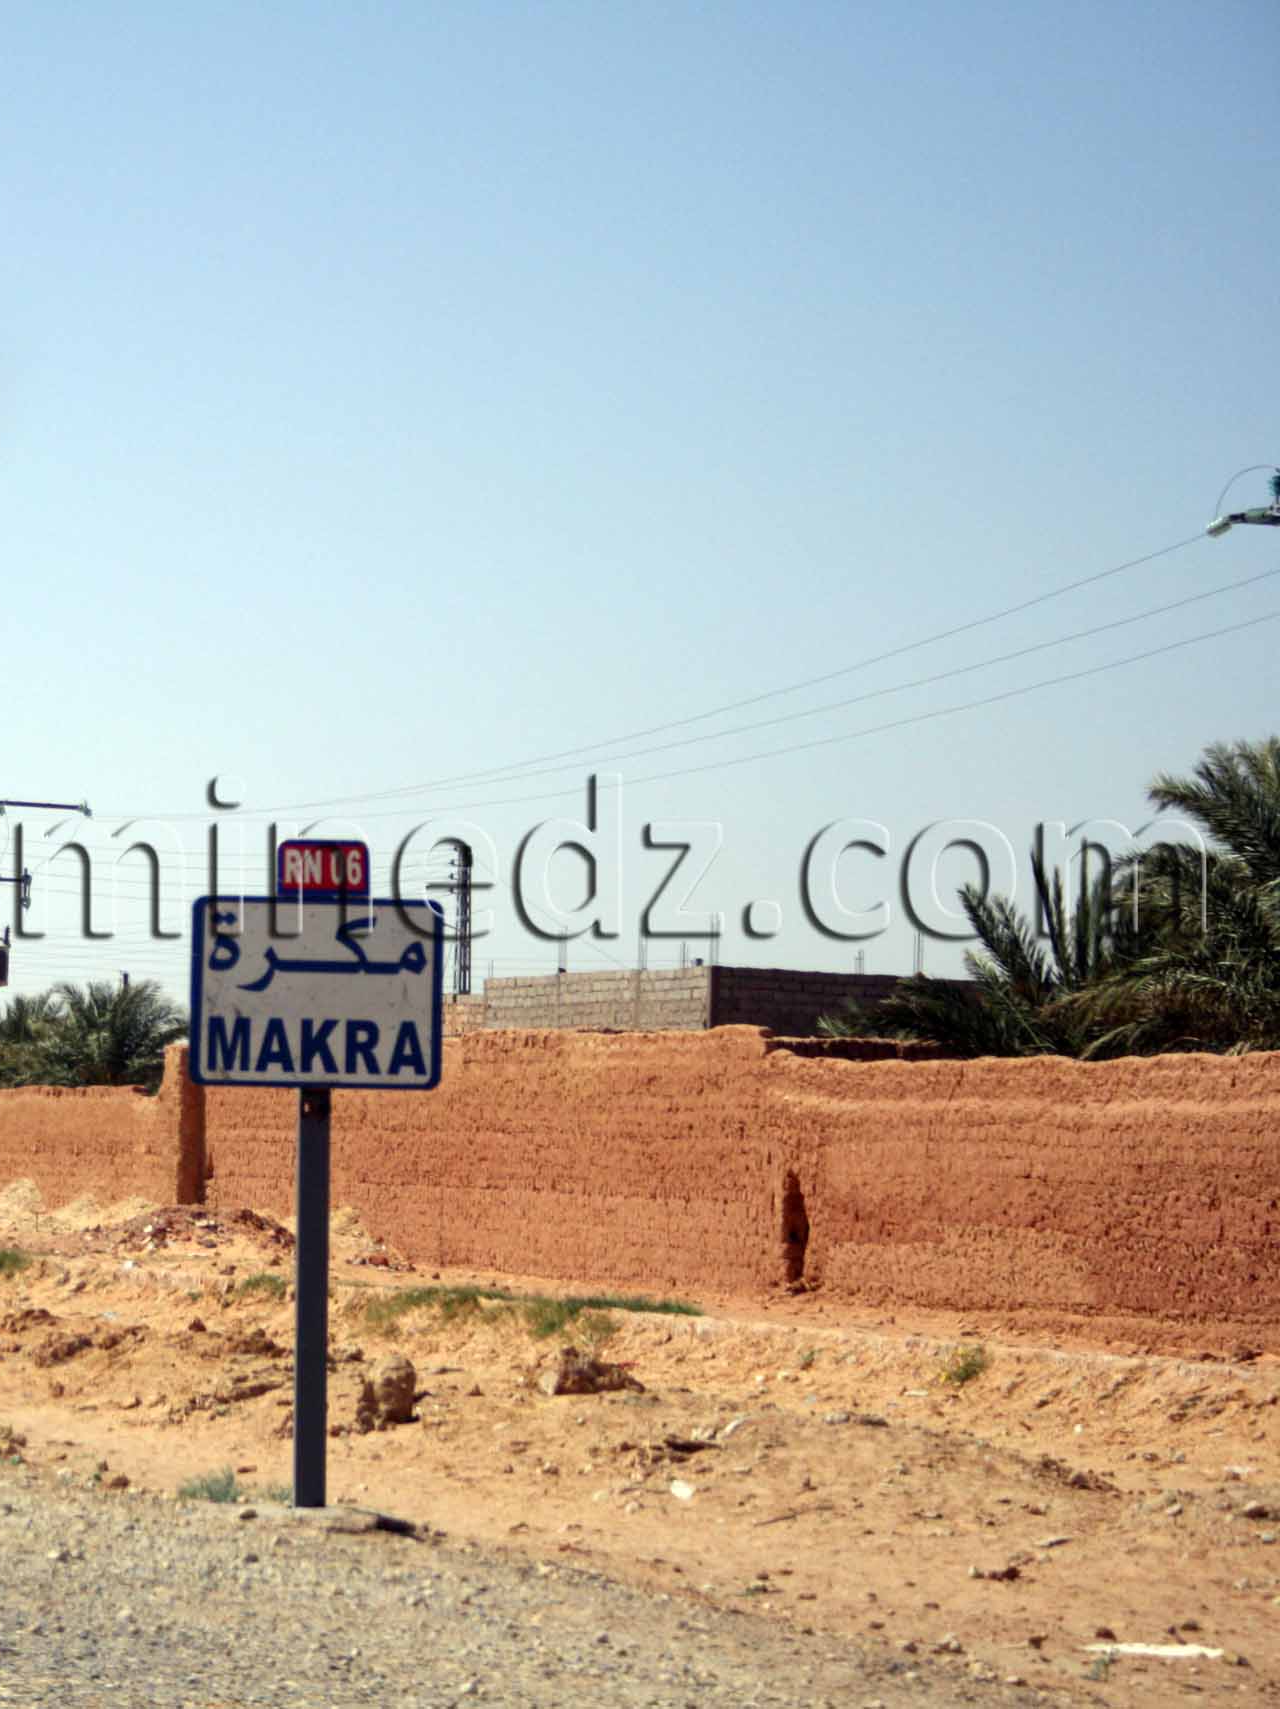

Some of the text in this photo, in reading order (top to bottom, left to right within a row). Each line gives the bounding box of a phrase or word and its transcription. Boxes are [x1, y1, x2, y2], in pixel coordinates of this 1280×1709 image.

[284, 848, 323, 884] RN
[208, 911, 428, 992] مكرة
[206, 1016, 427, 1076] MAKRA
